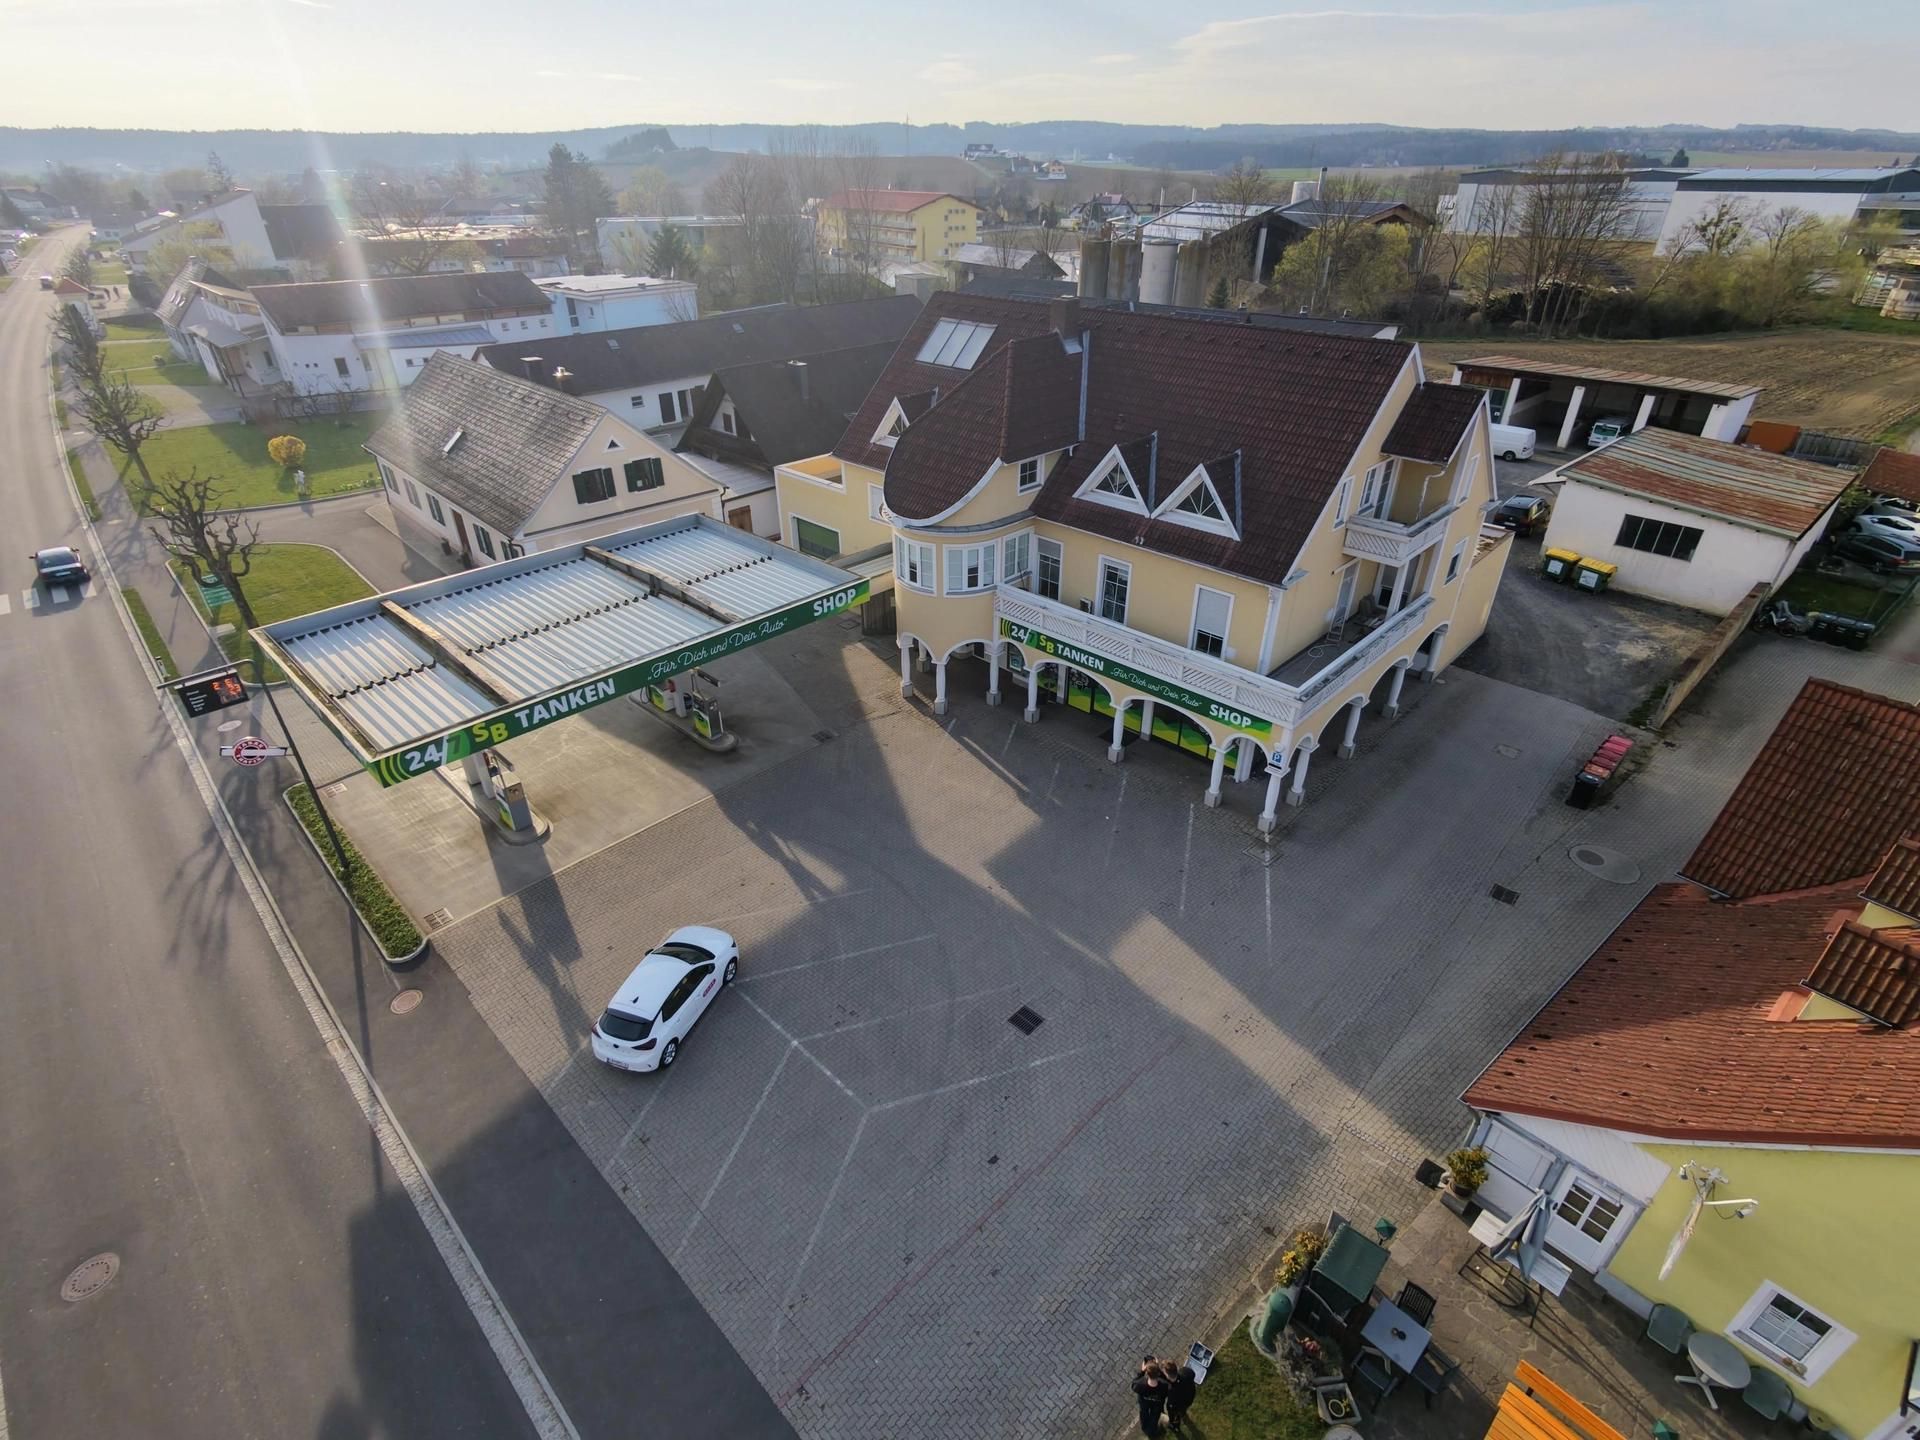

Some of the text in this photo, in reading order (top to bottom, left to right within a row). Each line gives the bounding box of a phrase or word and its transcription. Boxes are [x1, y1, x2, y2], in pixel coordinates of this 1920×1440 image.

[813, 588, 857, 617] SHOP
[678, 644, 708, 666] Dich
[710, 637, 728, 655] und
[729, 631, 757, 647] Dein
[1040, 635, 1054, 653] SB
[1057, 644, 1104, 671] TANKEN
[1128, 673, 1148, 687] Dich
[1148, 682, 1160, 692] und
[1160, 685, 1179, 699] Dein
[472, 722, 508, 743] SB
[515, 678, 615, 728] TANKEN
[1209, 704, 1252, 728] SHOP
